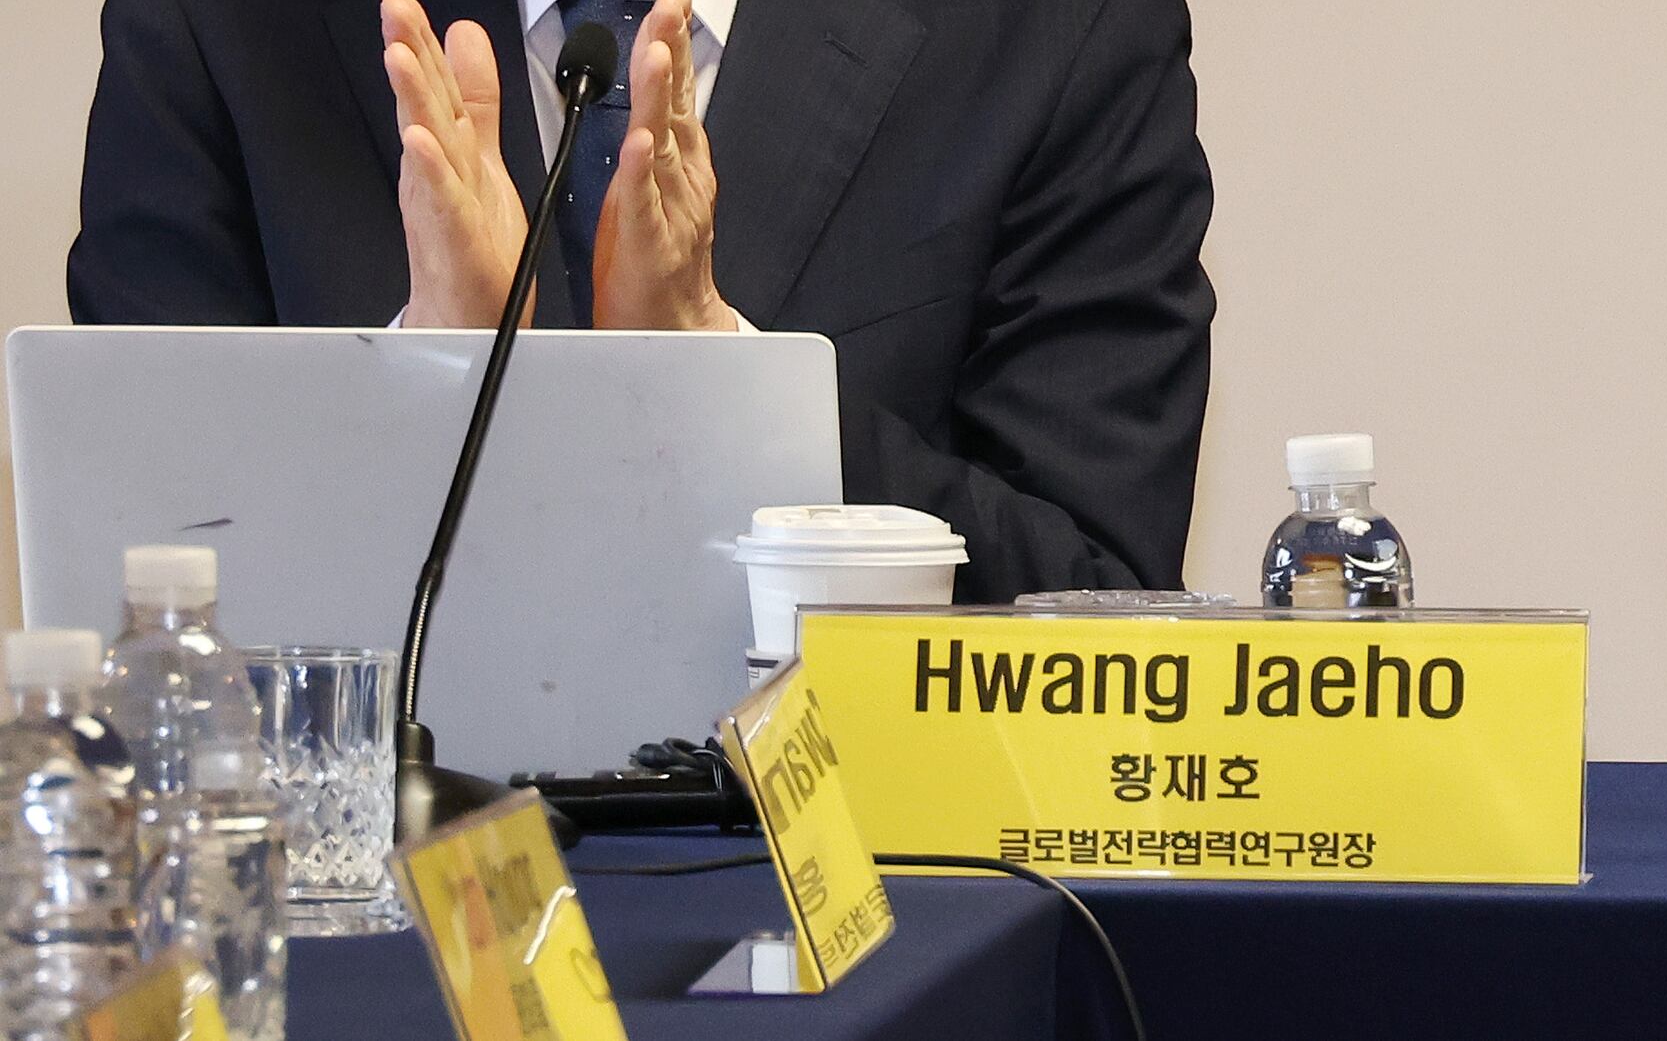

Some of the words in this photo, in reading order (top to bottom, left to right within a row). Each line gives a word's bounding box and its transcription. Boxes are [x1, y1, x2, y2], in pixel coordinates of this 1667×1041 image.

[914, 639, 1189, 723] Hwang
[1223, 644, 1464, 719] Jaeho
[1110, 753, 1260, 803] 황재호
[999, 828, 1377, 869] 글로벌전략협력연구원장
